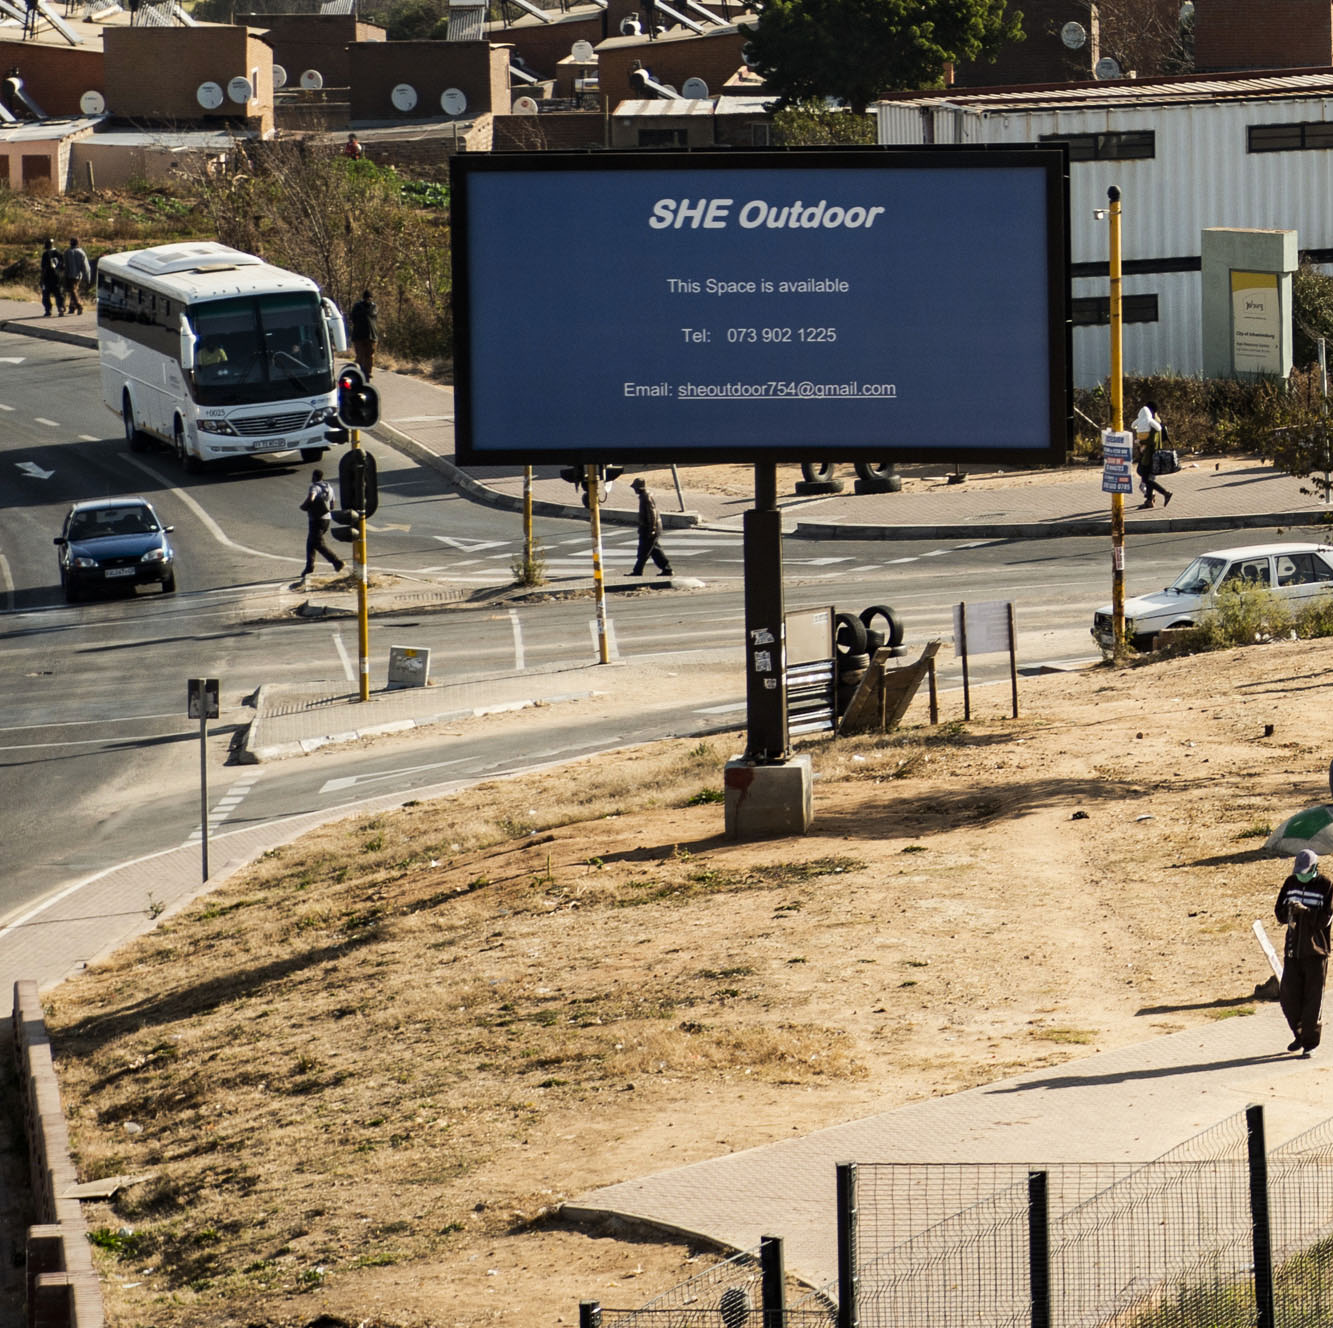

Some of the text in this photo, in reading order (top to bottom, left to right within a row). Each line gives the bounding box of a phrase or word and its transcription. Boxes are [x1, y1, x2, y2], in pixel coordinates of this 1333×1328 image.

[648, 198, 886, 230] SHE Outdoor
[666, 278, 850, 297] This Space is available
[681, 327, 837, 343] Tel: 073 902 1225
[624, 381, 897, 400] Email: sheoutdoor754@gmail.com
